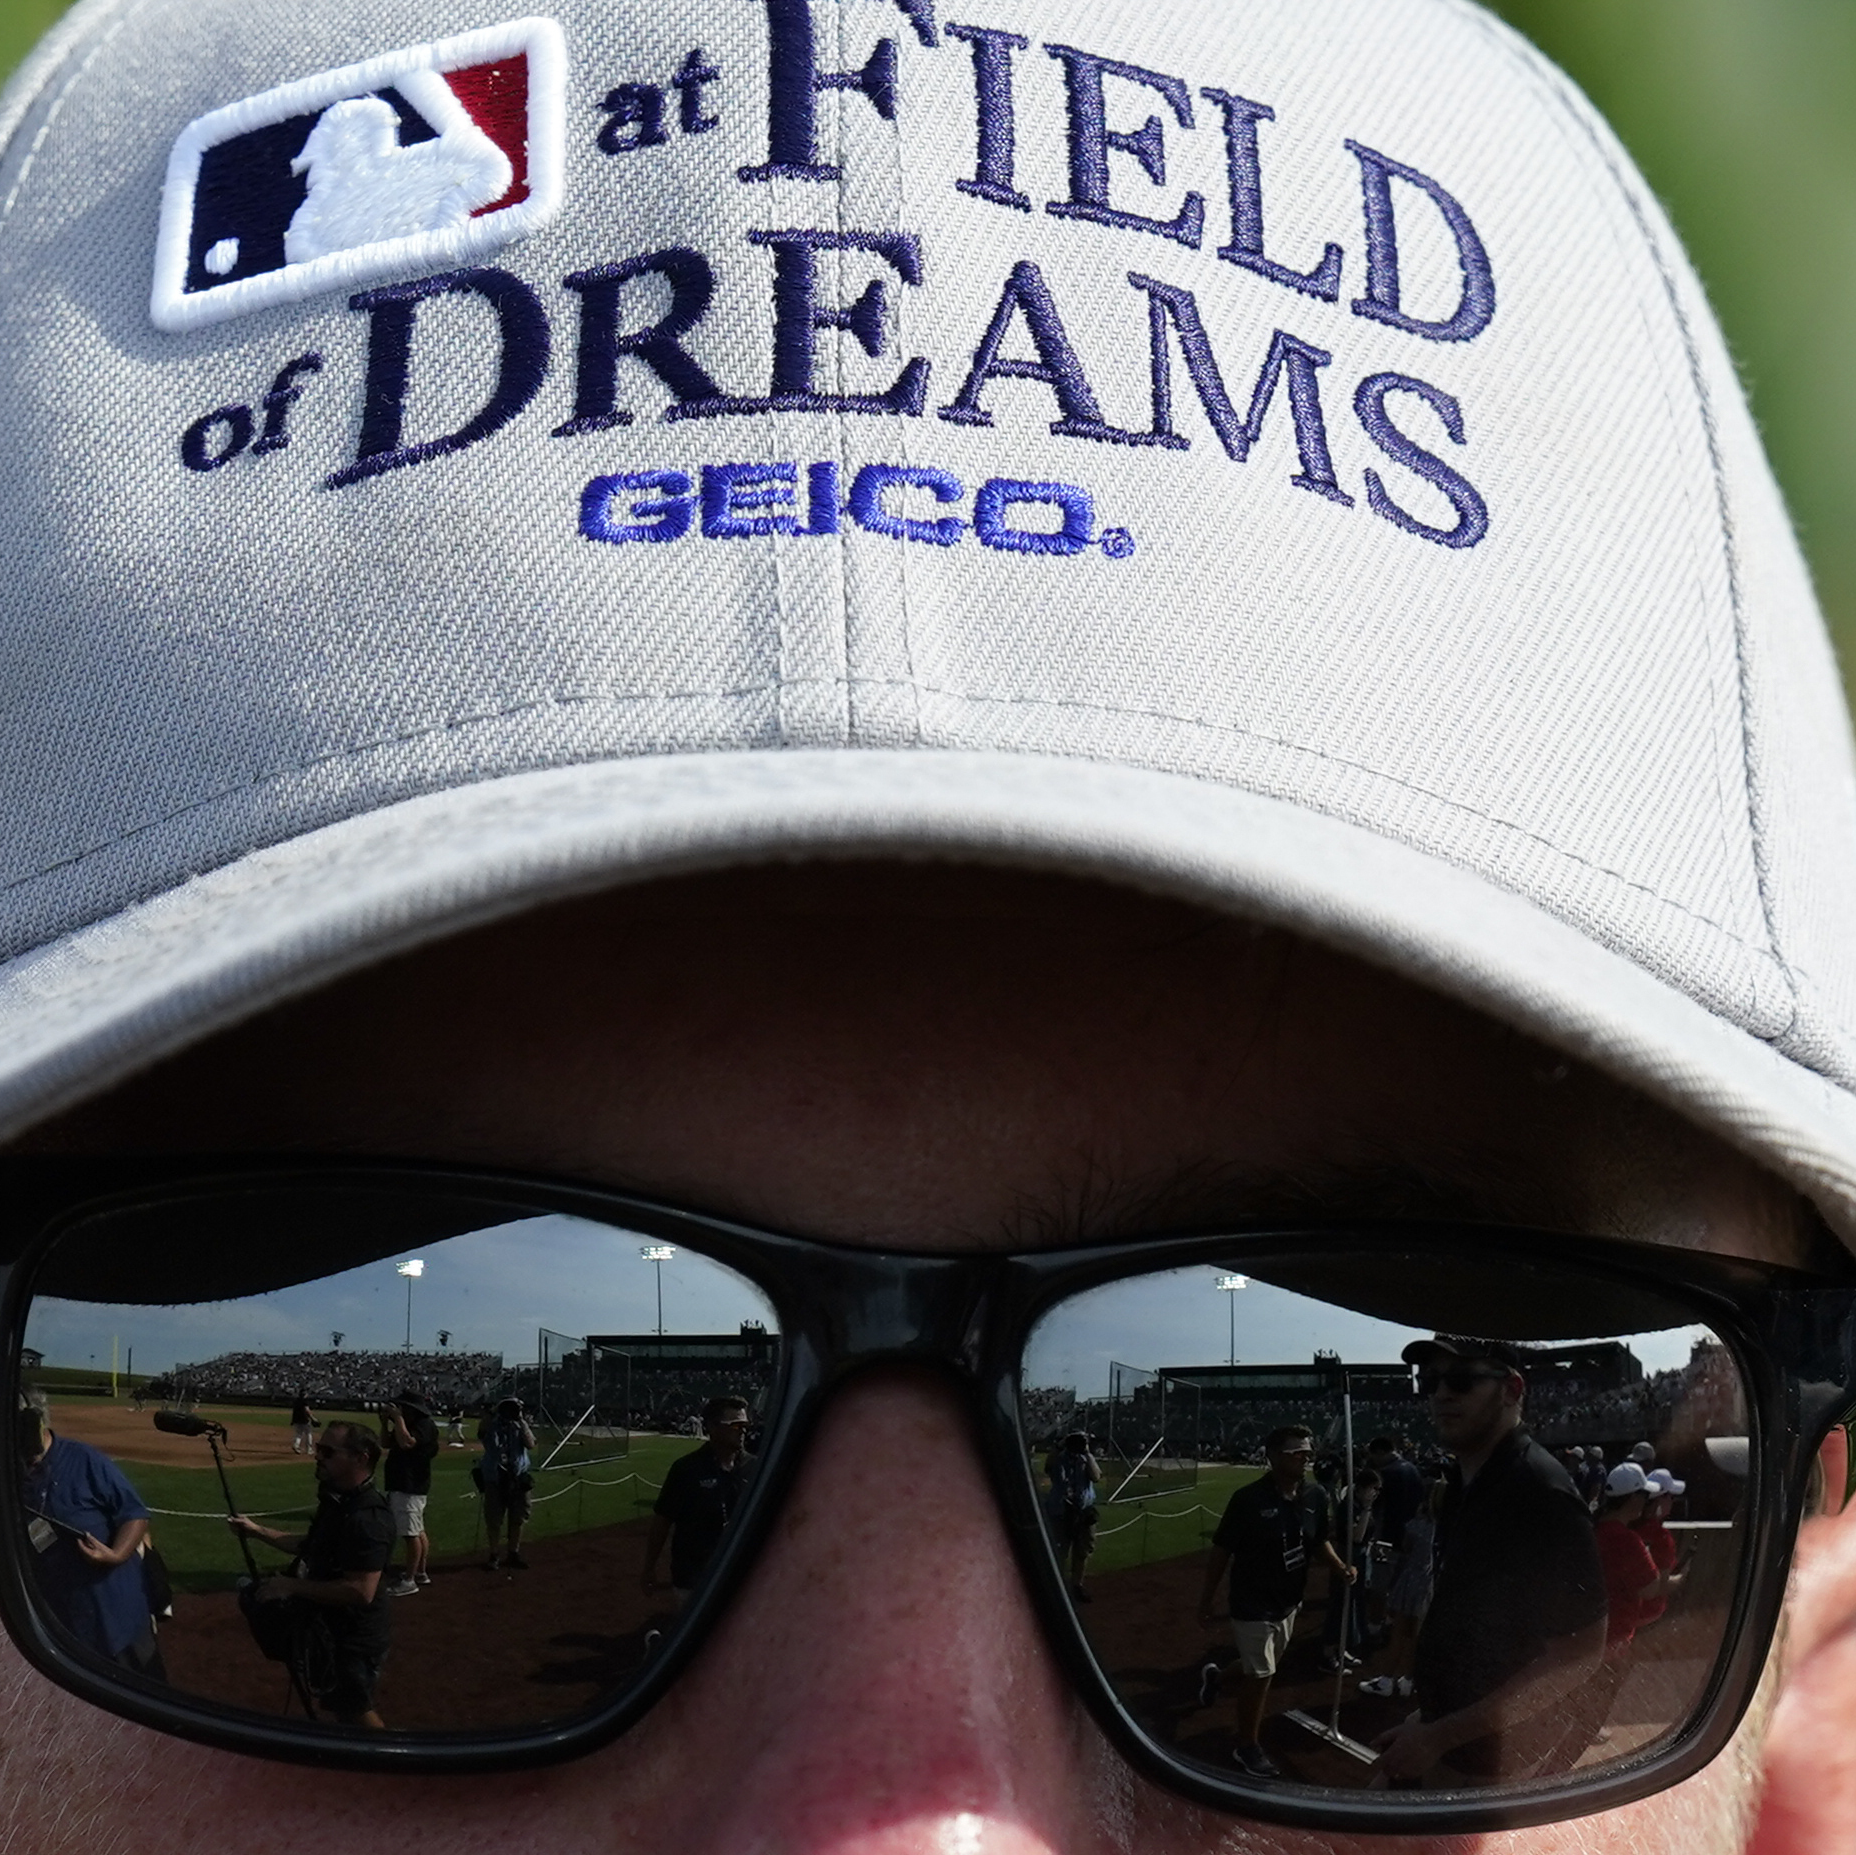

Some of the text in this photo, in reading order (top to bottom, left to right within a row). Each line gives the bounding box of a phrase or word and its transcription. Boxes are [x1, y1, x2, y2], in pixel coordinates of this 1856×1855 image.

[597, 48, 721, 152] at
[181, 226, 1491, 550] of DREAMS
